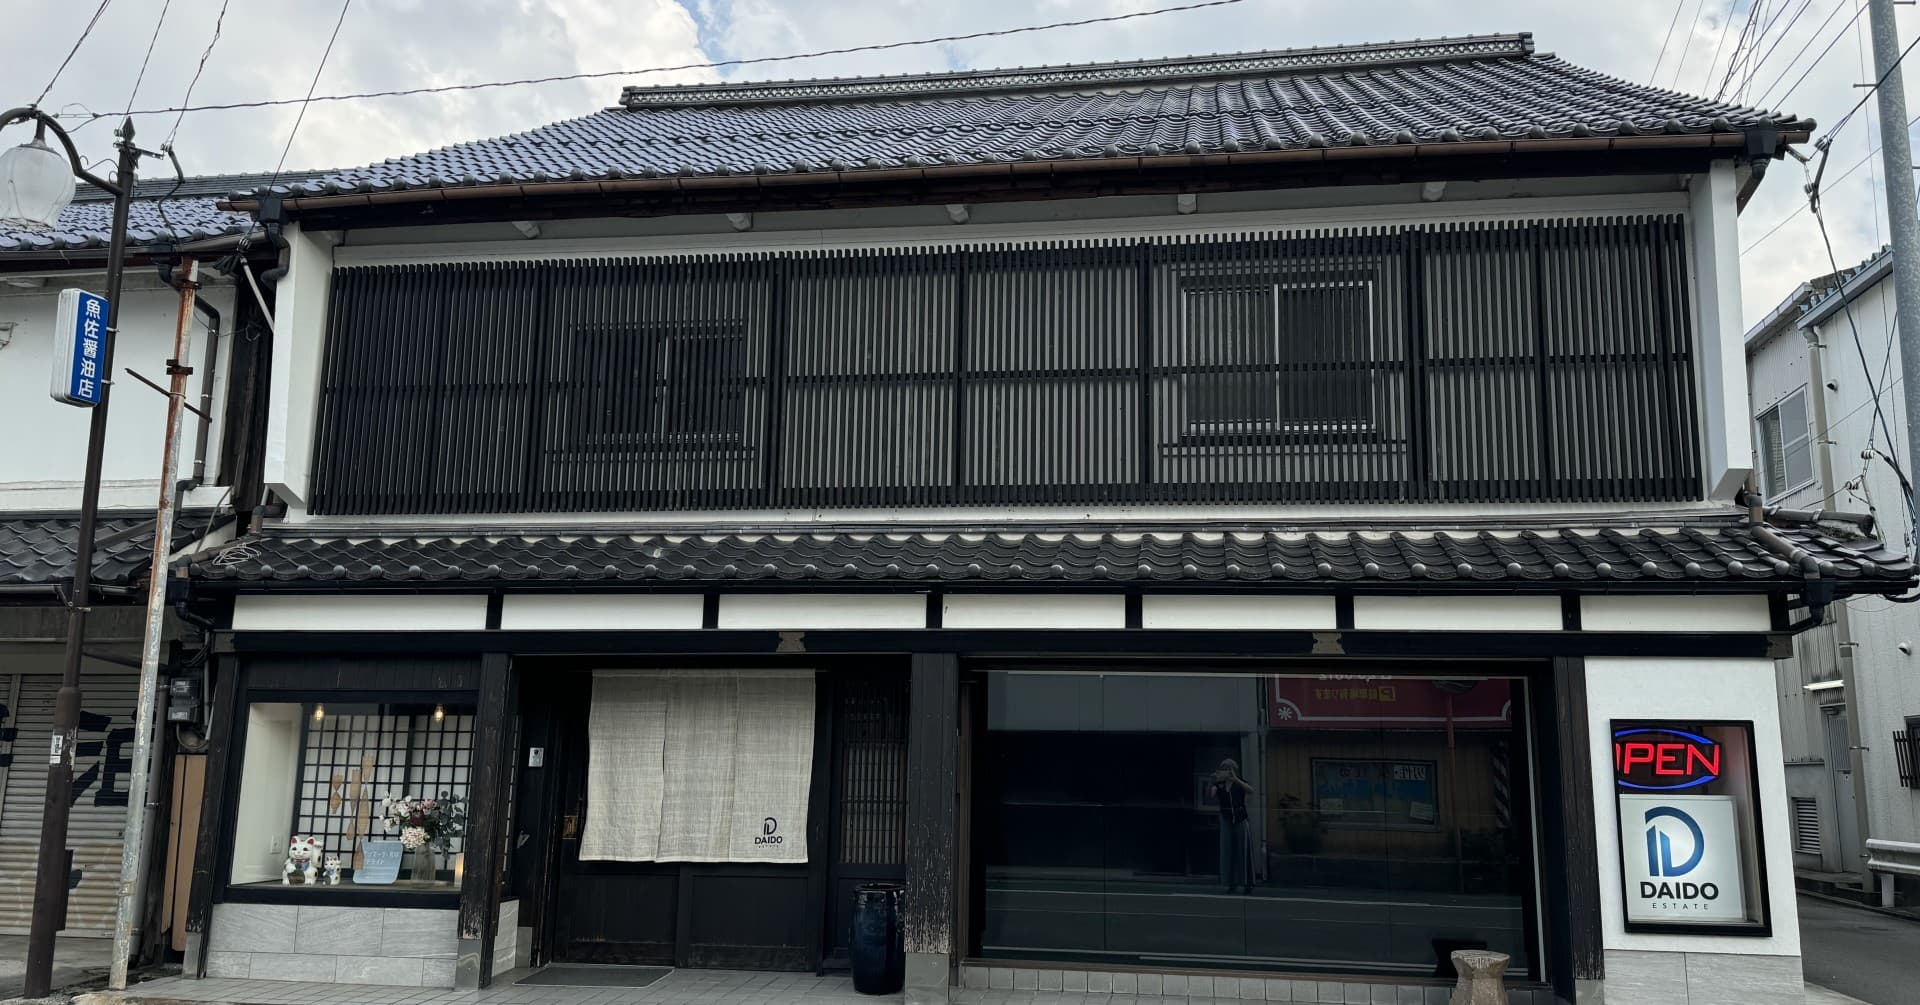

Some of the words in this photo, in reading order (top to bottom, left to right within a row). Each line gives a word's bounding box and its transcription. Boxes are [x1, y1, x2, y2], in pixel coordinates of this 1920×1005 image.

[78, 298, 101, 399] 魚佐醤油店
[1615, 743, 1720, 776] PEN
[754, 836, 783, 845] DAIDO
[1640, 881, 1719, 900] DAIDO
[1652, 902, 1709, 910] ESTATE
